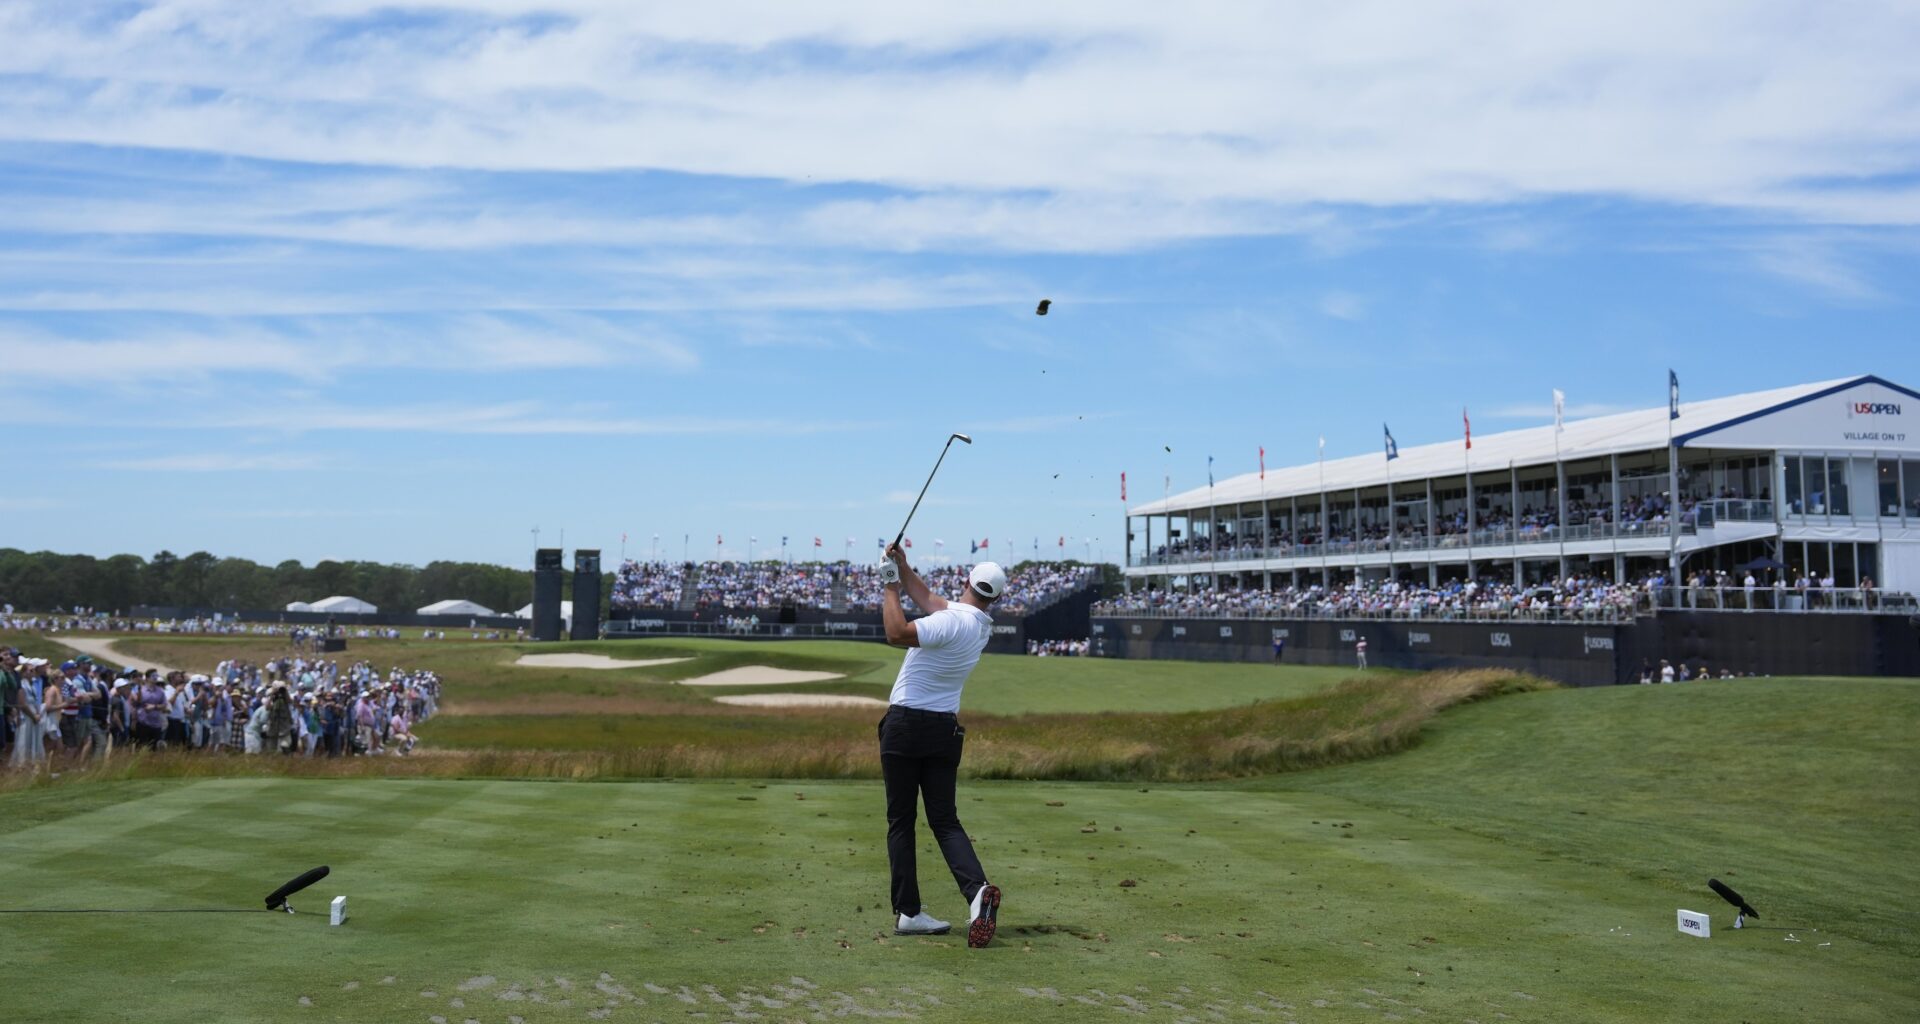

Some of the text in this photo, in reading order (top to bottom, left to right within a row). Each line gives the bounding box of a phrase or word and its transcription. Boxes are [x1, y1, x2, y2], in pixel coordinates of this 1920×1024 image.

[1844, 432, 1906, 441] VILLAGE ON 17
